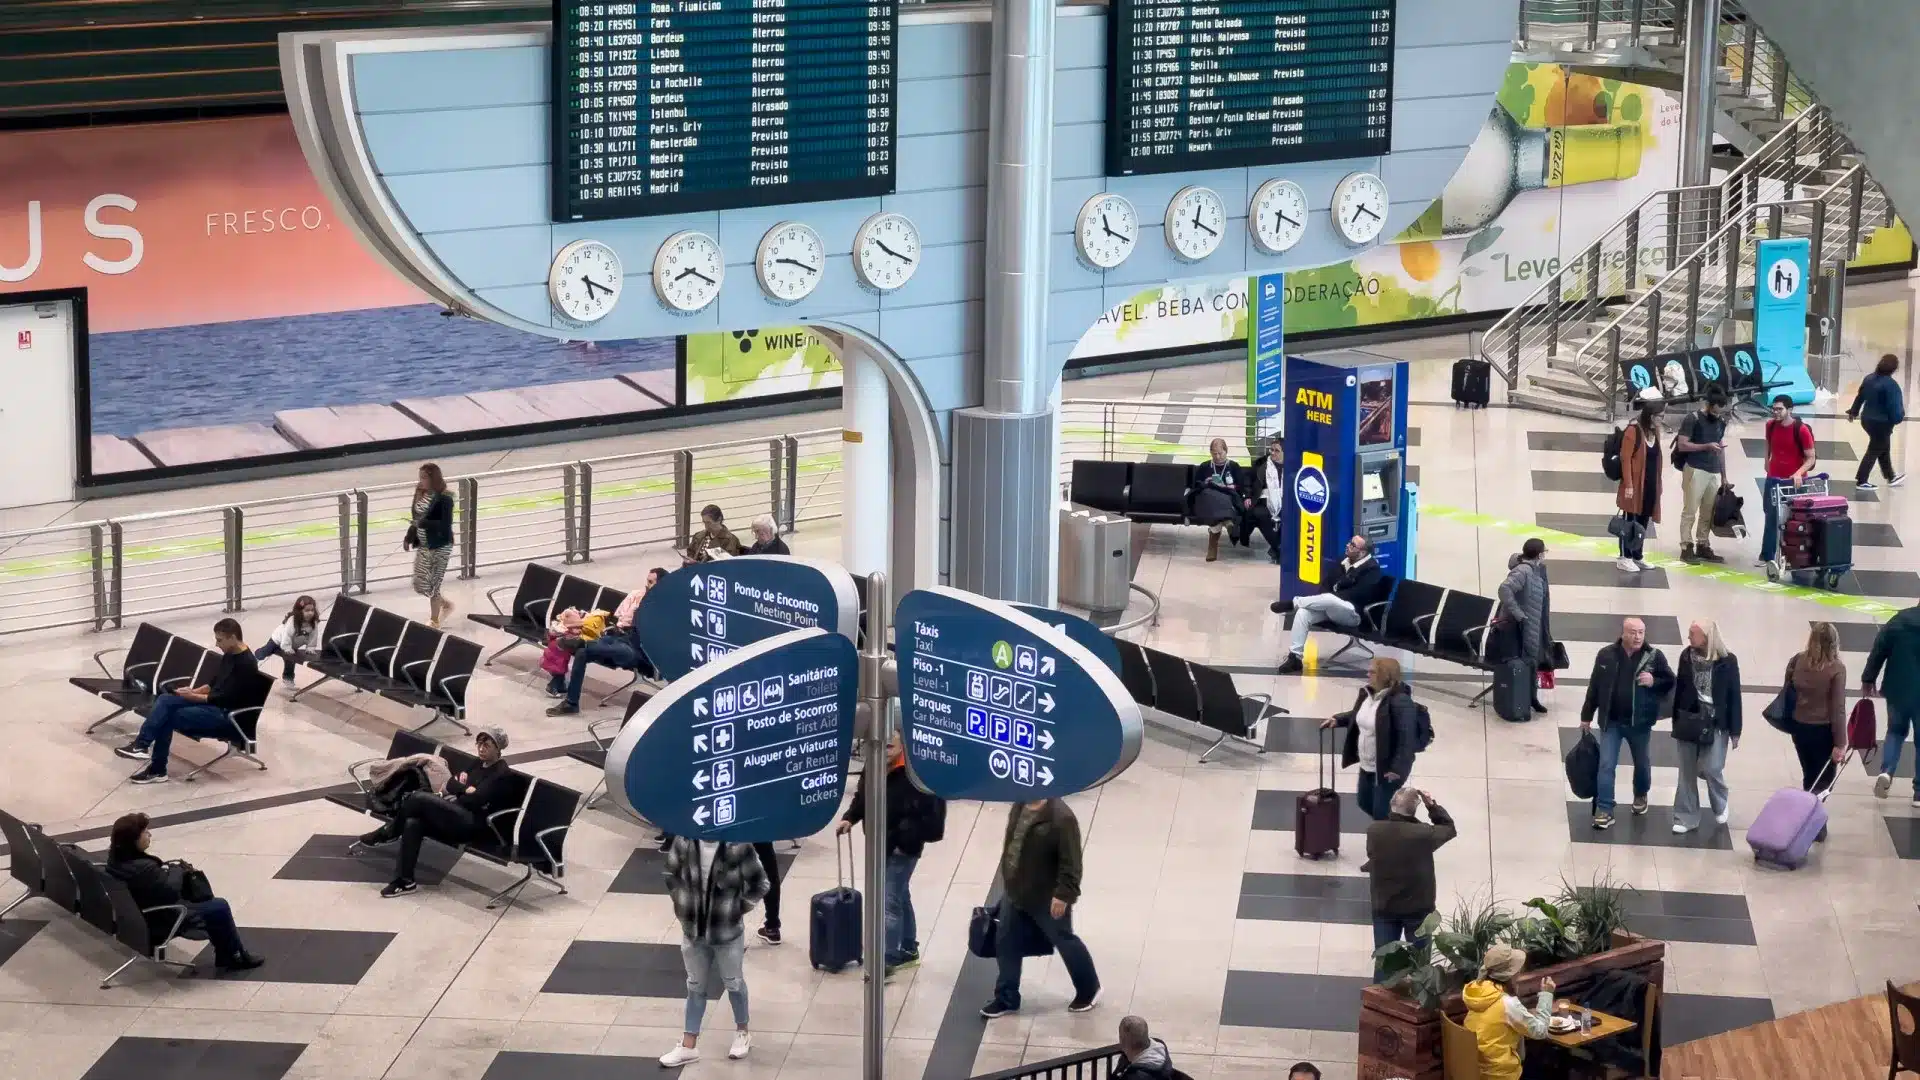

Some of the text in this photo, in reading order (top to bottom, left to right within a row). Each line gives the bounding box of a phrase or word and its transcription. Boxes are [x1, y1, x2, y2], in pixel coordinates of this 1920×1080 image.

[580, 6, 603, 16] 08:50
[580, 21, 603, 32] 09:20
[869, 7, 890, 17] 09:18
[580, 36, 603, 47] 09:40
[869, 21, 890, 31] 09:36
[580, 52, 603, 62] 09:50
[869, 36, 890, 46] 09:49
[580, 67, 603, 78] 09:50
[868, 50, 890, 60] 09:40
[580, 82, 603, 93] 09:55
[868, 64, 889, 75] 09:53
[580, 97, 603, 108] 10:05
[869, 79, 889, 89] 10:14
[580, 113, 603, 123] 10:05
[869, 93, 888, 104] 10:31
[581, 128, 603, 139] 10:10
[868, 108, 889, 118] 09:58
[580, 143, 603, 154] 10:30
[868, 122, 888, 133] 10:27
[580, 158, 603, 169] 10:35
[868, 136, 888, 147] 10:25
[580, 173, 603, 184] 10:45
[868, 151, 888, 161] 10:23
[580, 188, 603, 199] 10:50
[868, 165, 888, 175] 10:45
[1504, 254, 1560, 282] Leve
[1158, 297, 1204, 317] BEBA
[1296, 387, 1332, 411] ATM
[1307, 409, 1332, 425] HERE
[1306, 521, 1315, 562] ATM
[735, 582, 819, 613] Ponto de Encontro
[754, 602, 818, 628] Meeting Point
[915, 621, 939, 638] Táxis
[915, 637, 933, 652] Taxi
[996, 644, 1009, 666] A
[789, 666, 838, 686] Sanitários
[913, 658, 944, 675] Piso -1
[806, 682, 837, 697] Toilets
[913, 674, 949, 692] Level -1
[913, 693, 951, 714] Parques
[748, 702, 837, 731] Posto de Socorros
[796, 716, 837, 734] First Aid
[913, 710, 962, 733] Car Parking
[913, 729, 943, 746] Metro
[744, 738, 838, 767] Aluguer de Viaturas
[786, 750, 838, 773] Car Rental
[913, 743, 958, 766] Light Rail
[802, 772, 838, 790] Cacifos
[800, 788, 838, 805] Lockers
